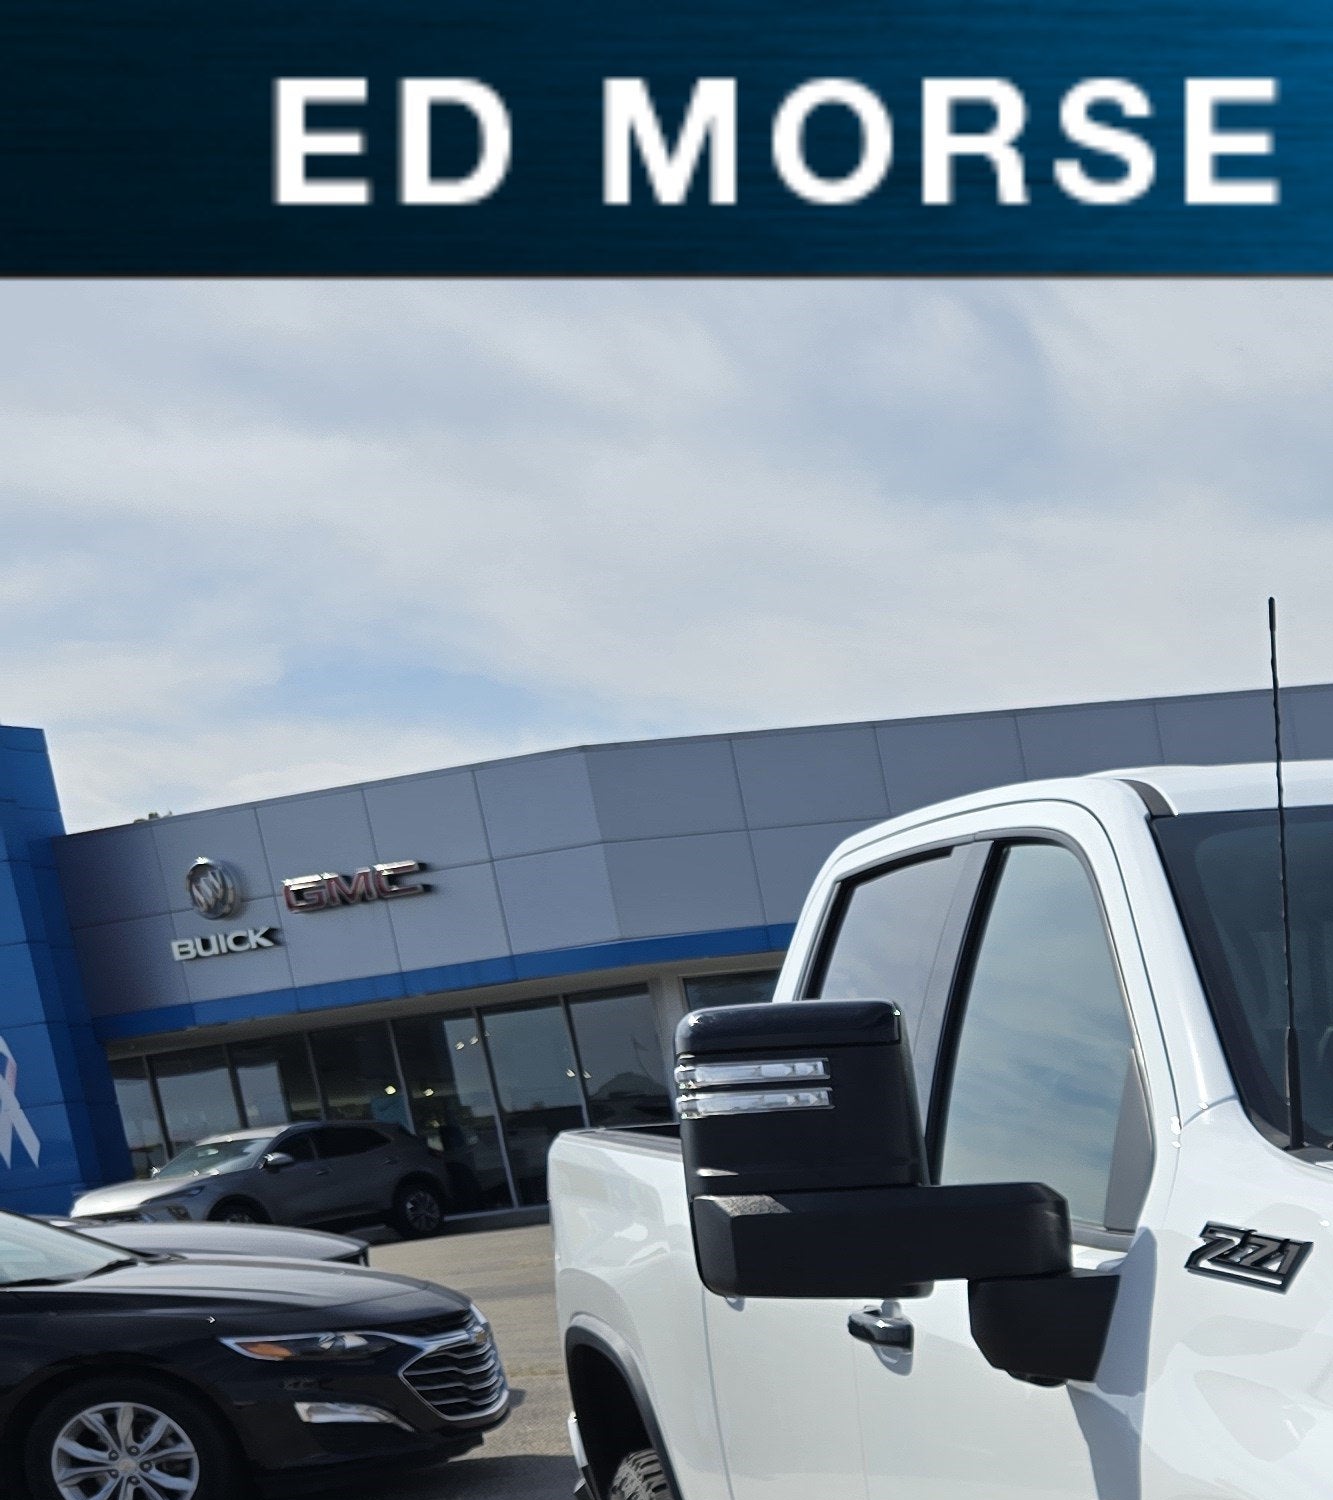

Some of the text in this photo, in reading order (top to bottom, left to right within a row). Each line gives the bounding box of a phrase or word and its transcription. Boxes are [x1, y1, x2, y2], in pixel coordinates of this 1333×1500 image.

[282, 859, 425, 914] GMC
[171, 926, 274, 961] BUICK
[1184, 1221, 1314, 1294] Z71
